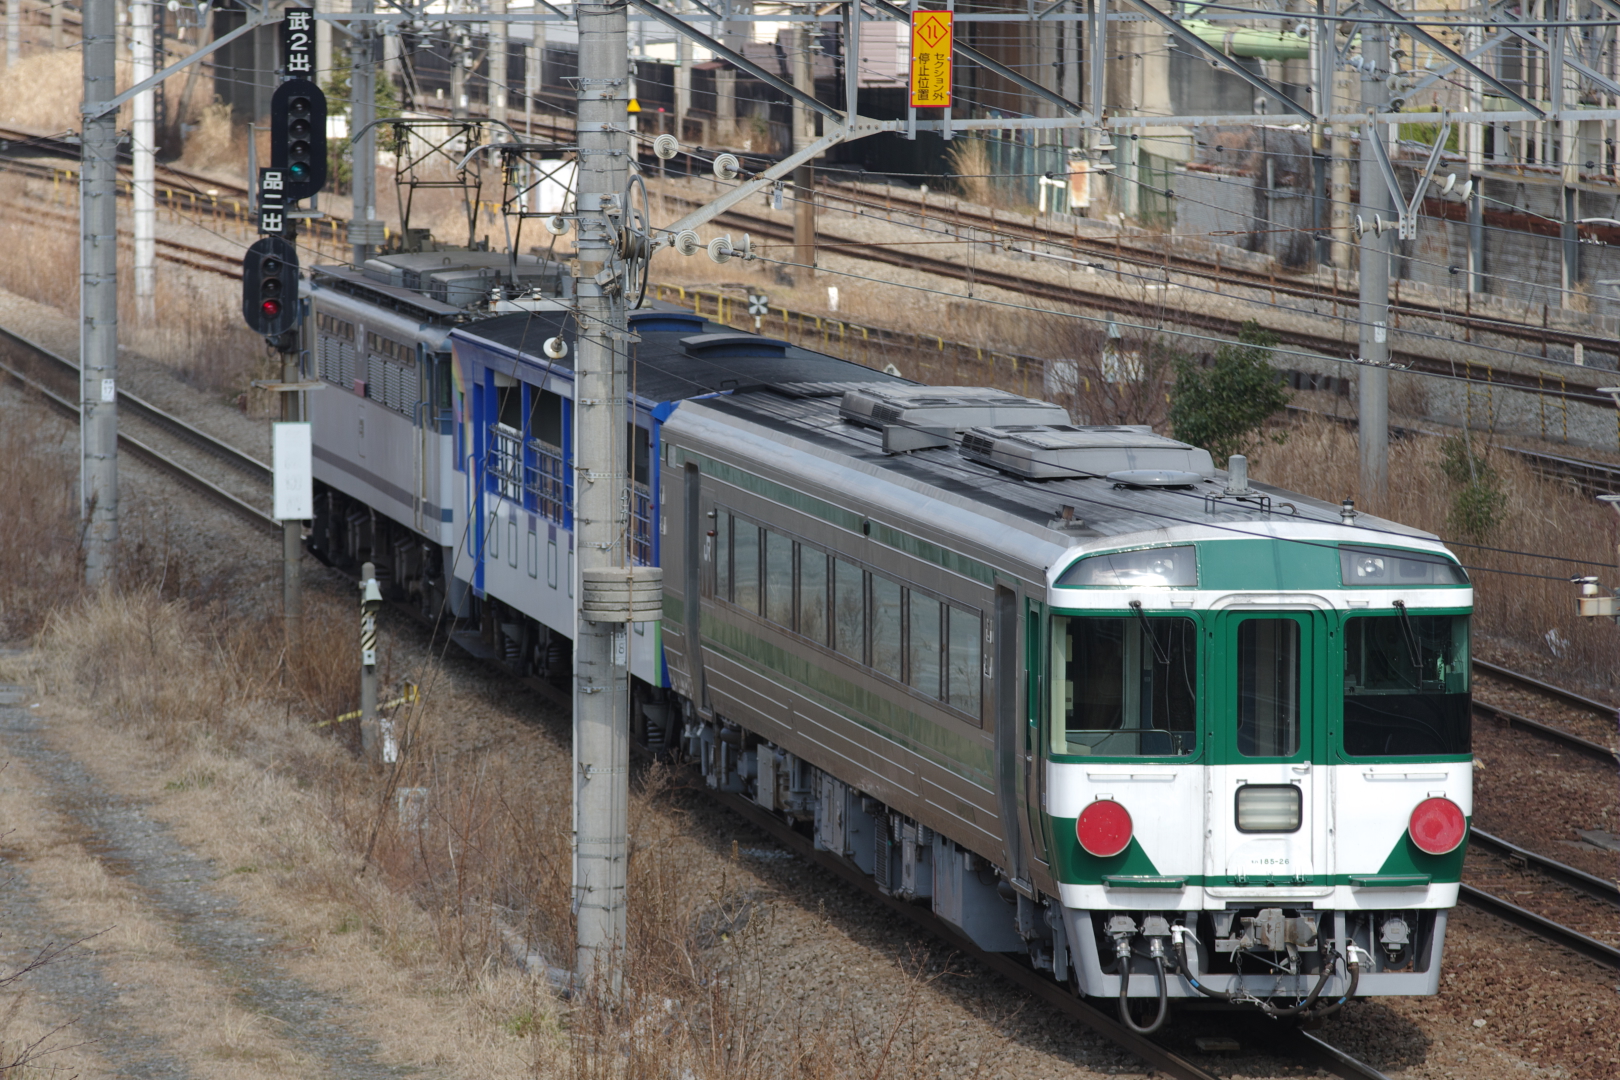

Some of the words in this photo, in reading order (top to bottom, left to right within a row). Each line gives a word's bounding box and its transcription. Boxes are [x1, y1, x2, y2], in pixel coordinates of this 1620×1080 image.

[287, 12, 312, 72] 武2出
[918, 53, 930, 101] 停止位置
[932, 53, 945, 101] セクション外
[703, 534, 712, 562] JR
